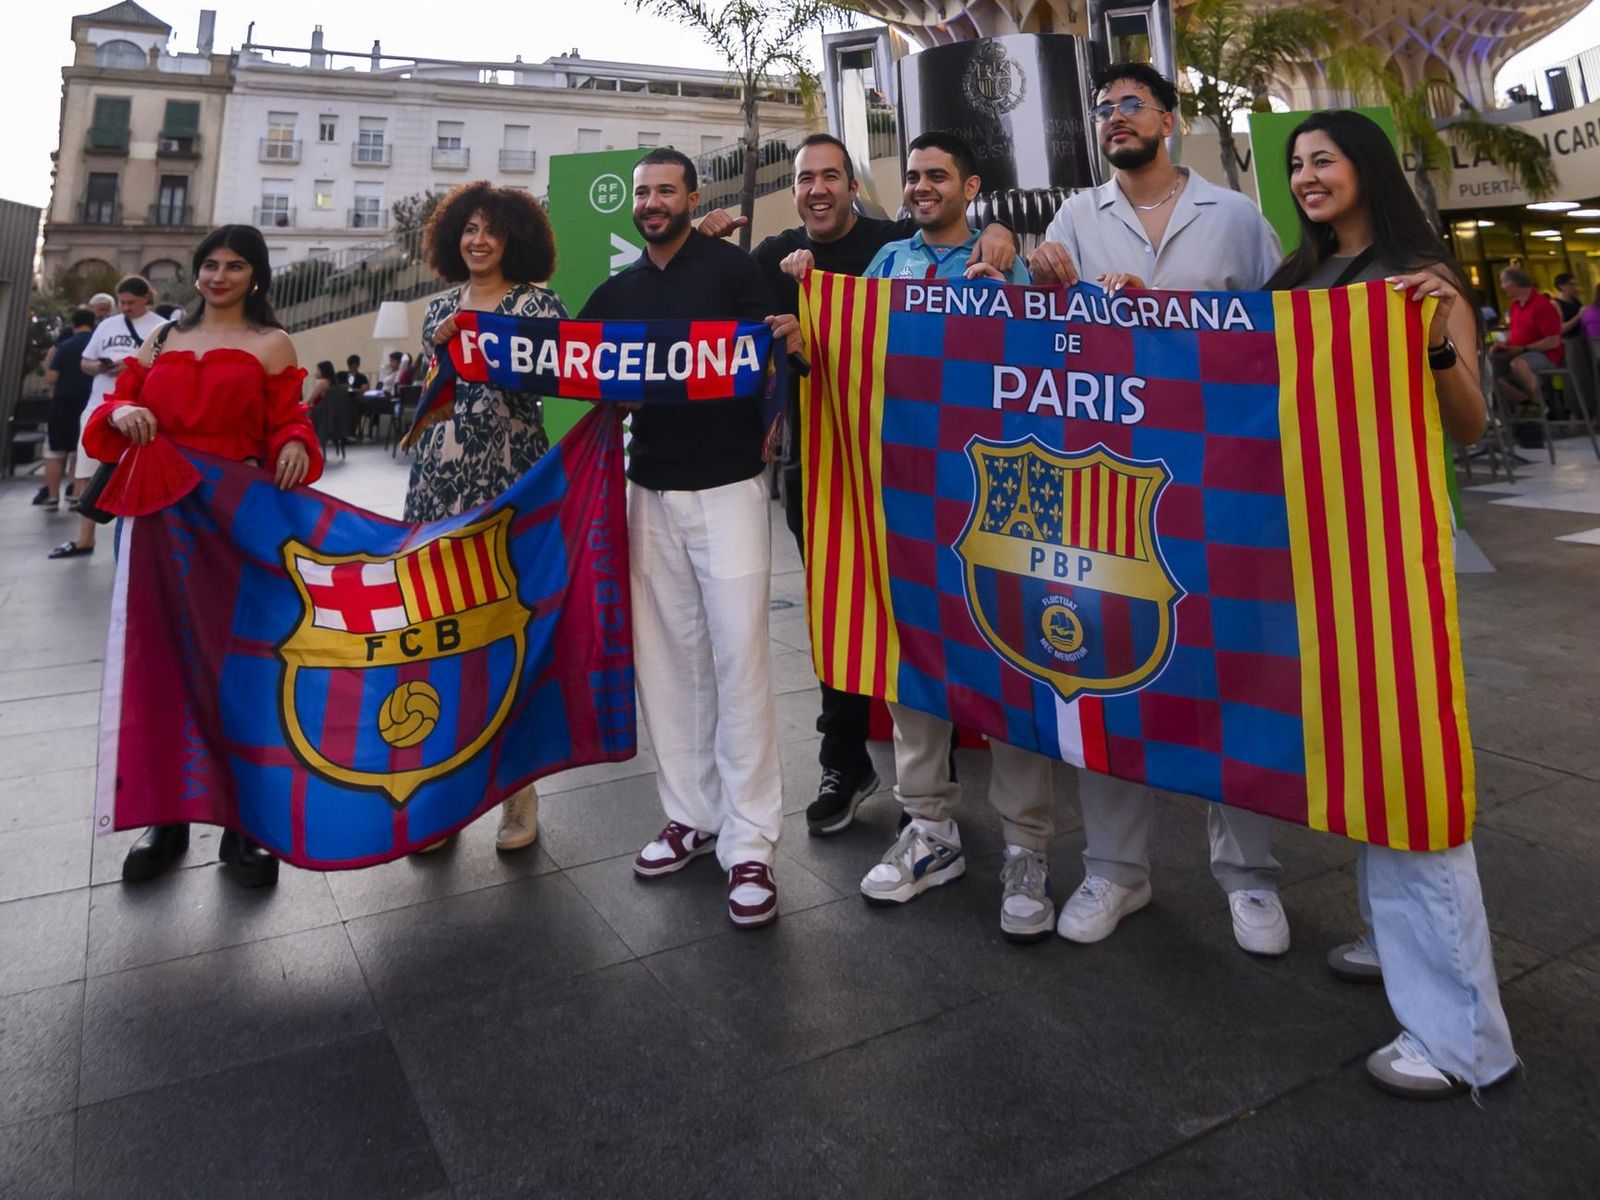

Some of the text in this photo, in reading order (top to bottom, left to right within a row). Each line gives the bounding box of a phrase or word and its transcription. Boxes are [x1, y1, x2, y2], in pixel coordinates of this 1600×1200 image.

[1459, 179, 1521, 197] PUERTA
[904, 284, 1255, 331] PENYA BLAUGRANA
[460, 329, 761, 382] FC BARCELONA
[1053, 333, 1082, 354] DE
[991, 364, 1147, 426] PARIS
[1030, 546, 1093, 581] PBP
[1041, 595, 1078, 611] FLUCTUAT
[364, 619, 461, 662] FCB
